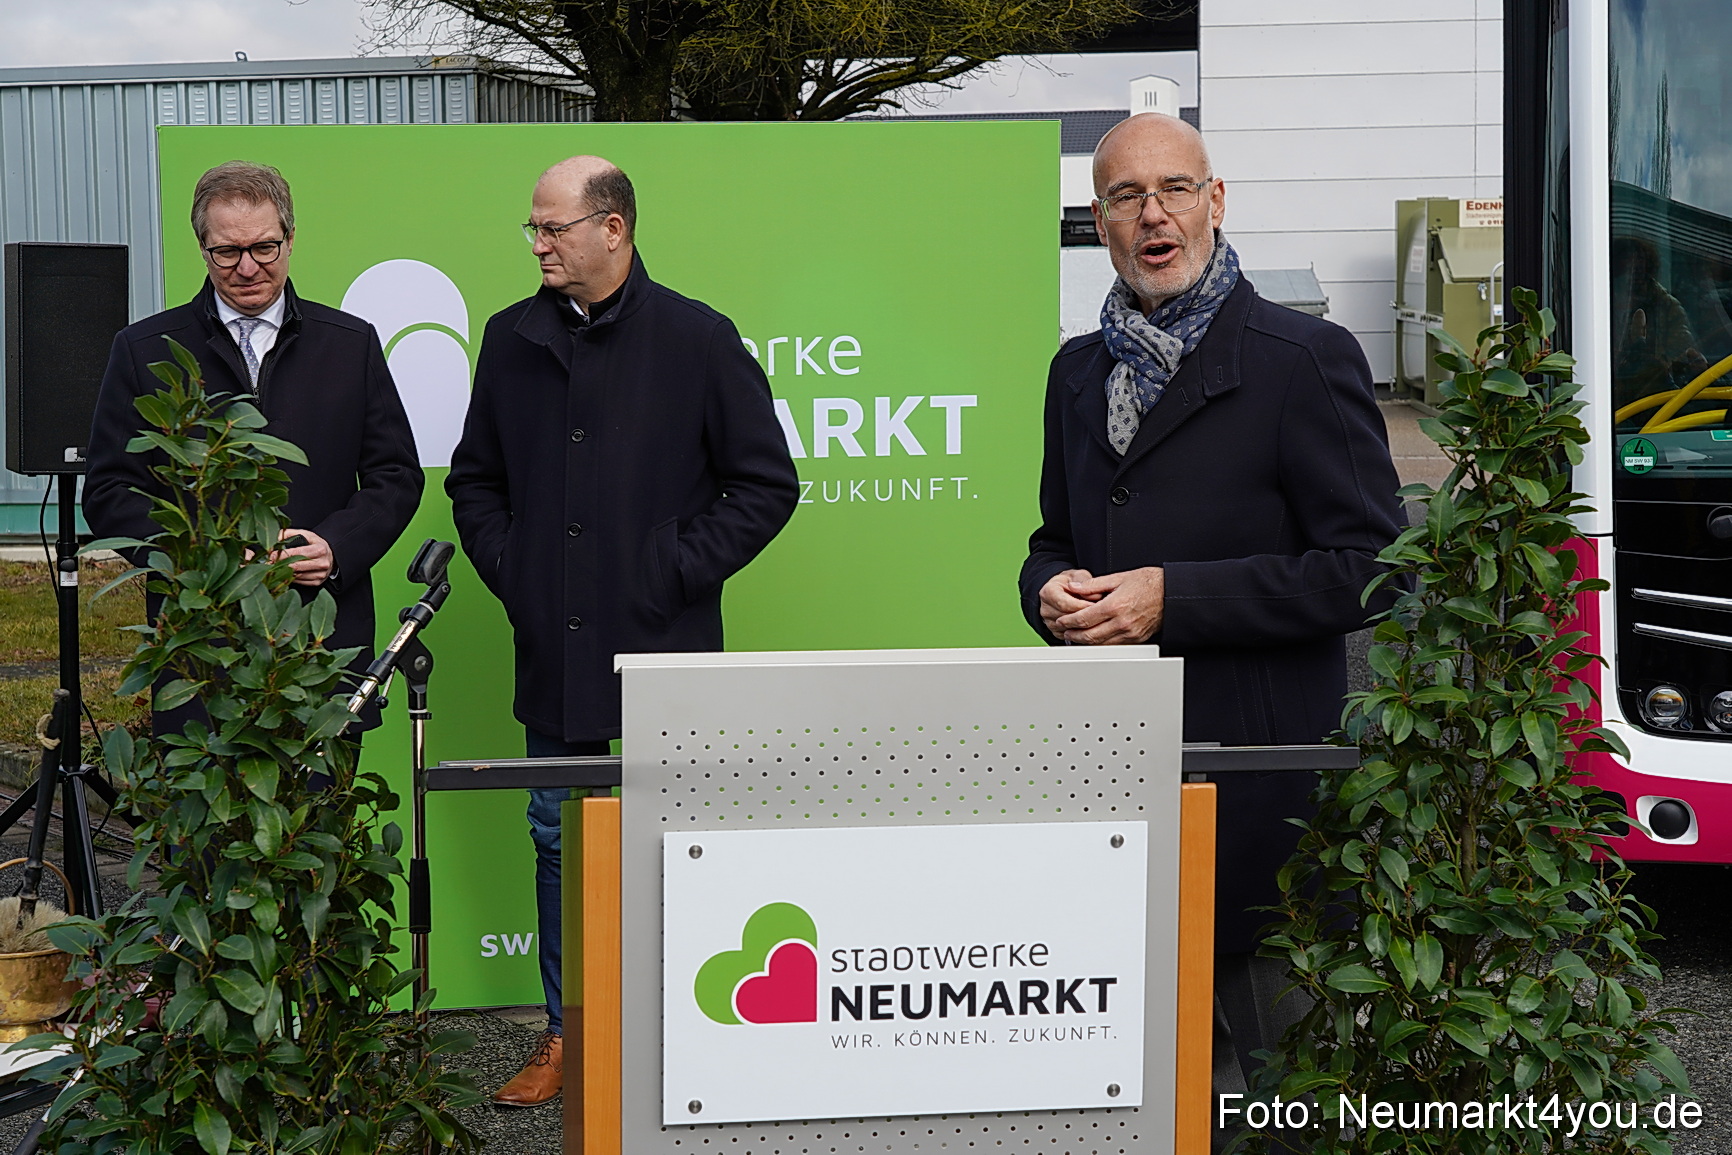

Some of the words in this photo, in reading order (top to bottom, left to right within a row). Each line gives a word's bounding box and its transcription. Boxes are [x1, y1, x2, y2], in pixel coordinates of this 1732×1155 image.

[1634, 440, 1644, 456] 4
[798, 477, 978, 504] ZUKUNFT.
[480, 932, 540, 958] sw
[831, 942, 1049, 973] stadtwerke
[831, 976, 1118, 1022] NEUMARKT
[831, 1033, 881, 1049] WIR.
[894, 1027, 995, 1047] KÖNNEN.
[1009, 1025, 1118, 1043] ZUKUNFT.
